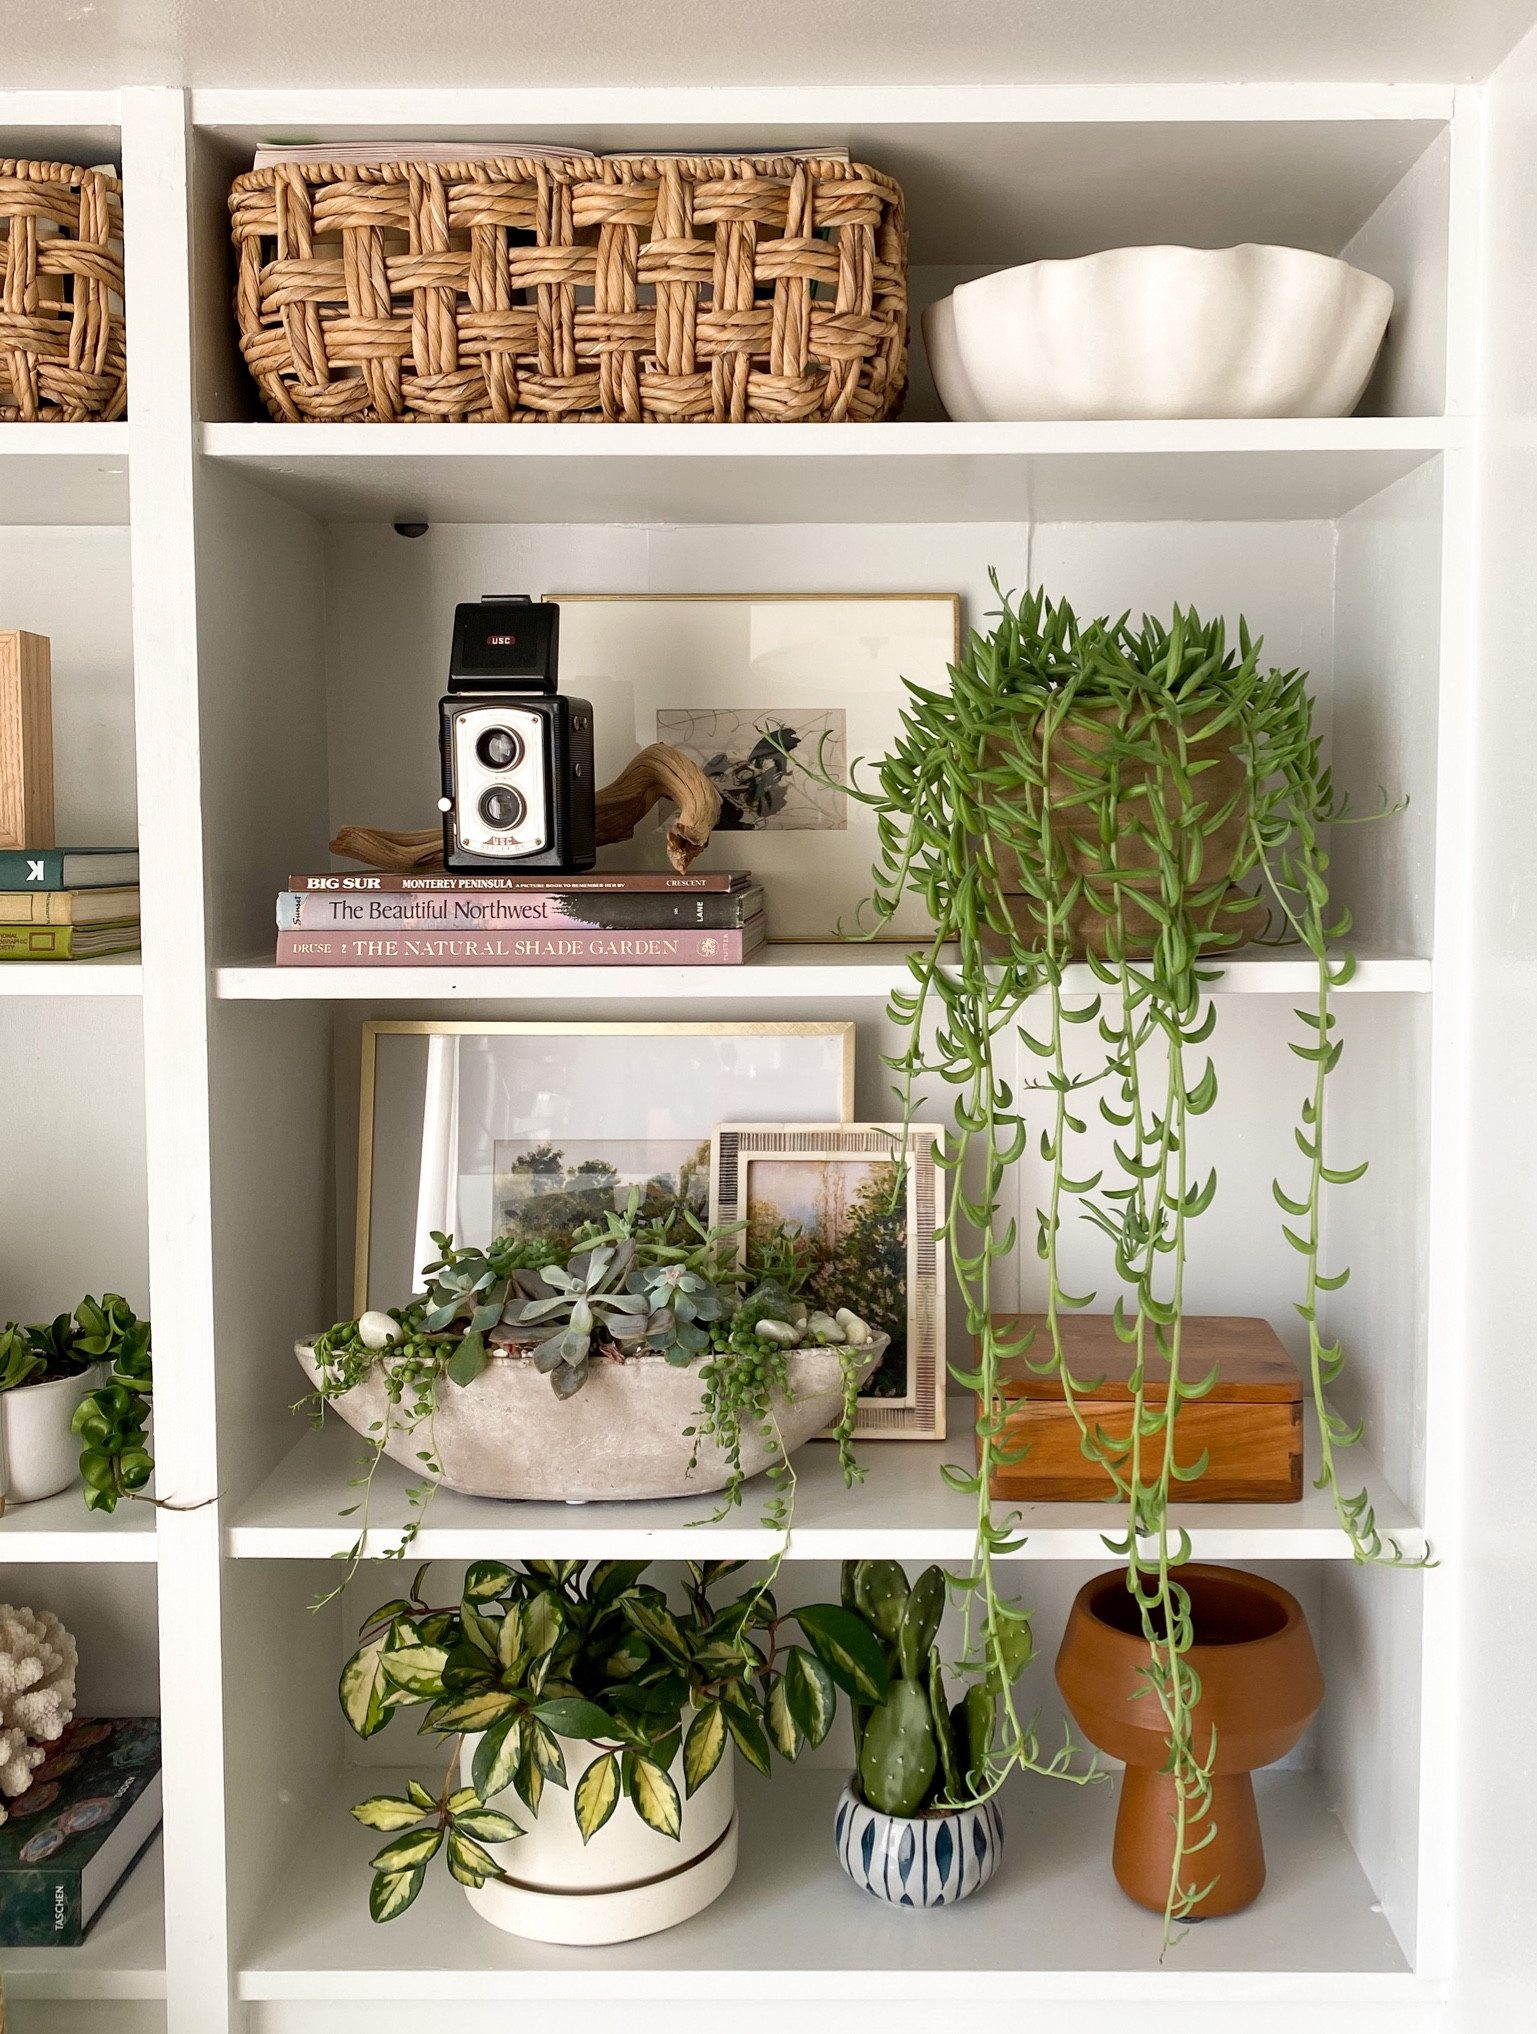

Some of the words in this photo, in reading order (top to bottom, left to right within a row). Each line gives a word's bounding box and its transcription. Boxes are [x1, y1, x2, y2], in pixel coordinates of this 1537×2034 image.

[492, 637, 511, 645] USC
[492, 837, 512, 845] USC
[26, 860, 44, 881] K
[307, 878, 339, 889] BIG
[342, 878, 381, 889] SUR
[402, 879, 457, 889] MONTEREY
[458, 879, 513, 889] PENINSULA
[293, 896, 302, 926] Sunset
[329, 900, 363, 920] The
[370, 900, 448, 920] Beautiful
[454, 899, 548, 920] Northwest
[696, 901, 704, 922] LANE
[293, 943, 332, 953] DRUSE
[352, 940, 399, 956] THE
[404, 940, 509, 956] NATURAL
[514, 940, 583, 955] SHADE
[589, 939, 679, 955] GARDEN
[113, 1776, 137, 1798] TASCHEN
[54, 1885, 64, 1932] TASCHEN
